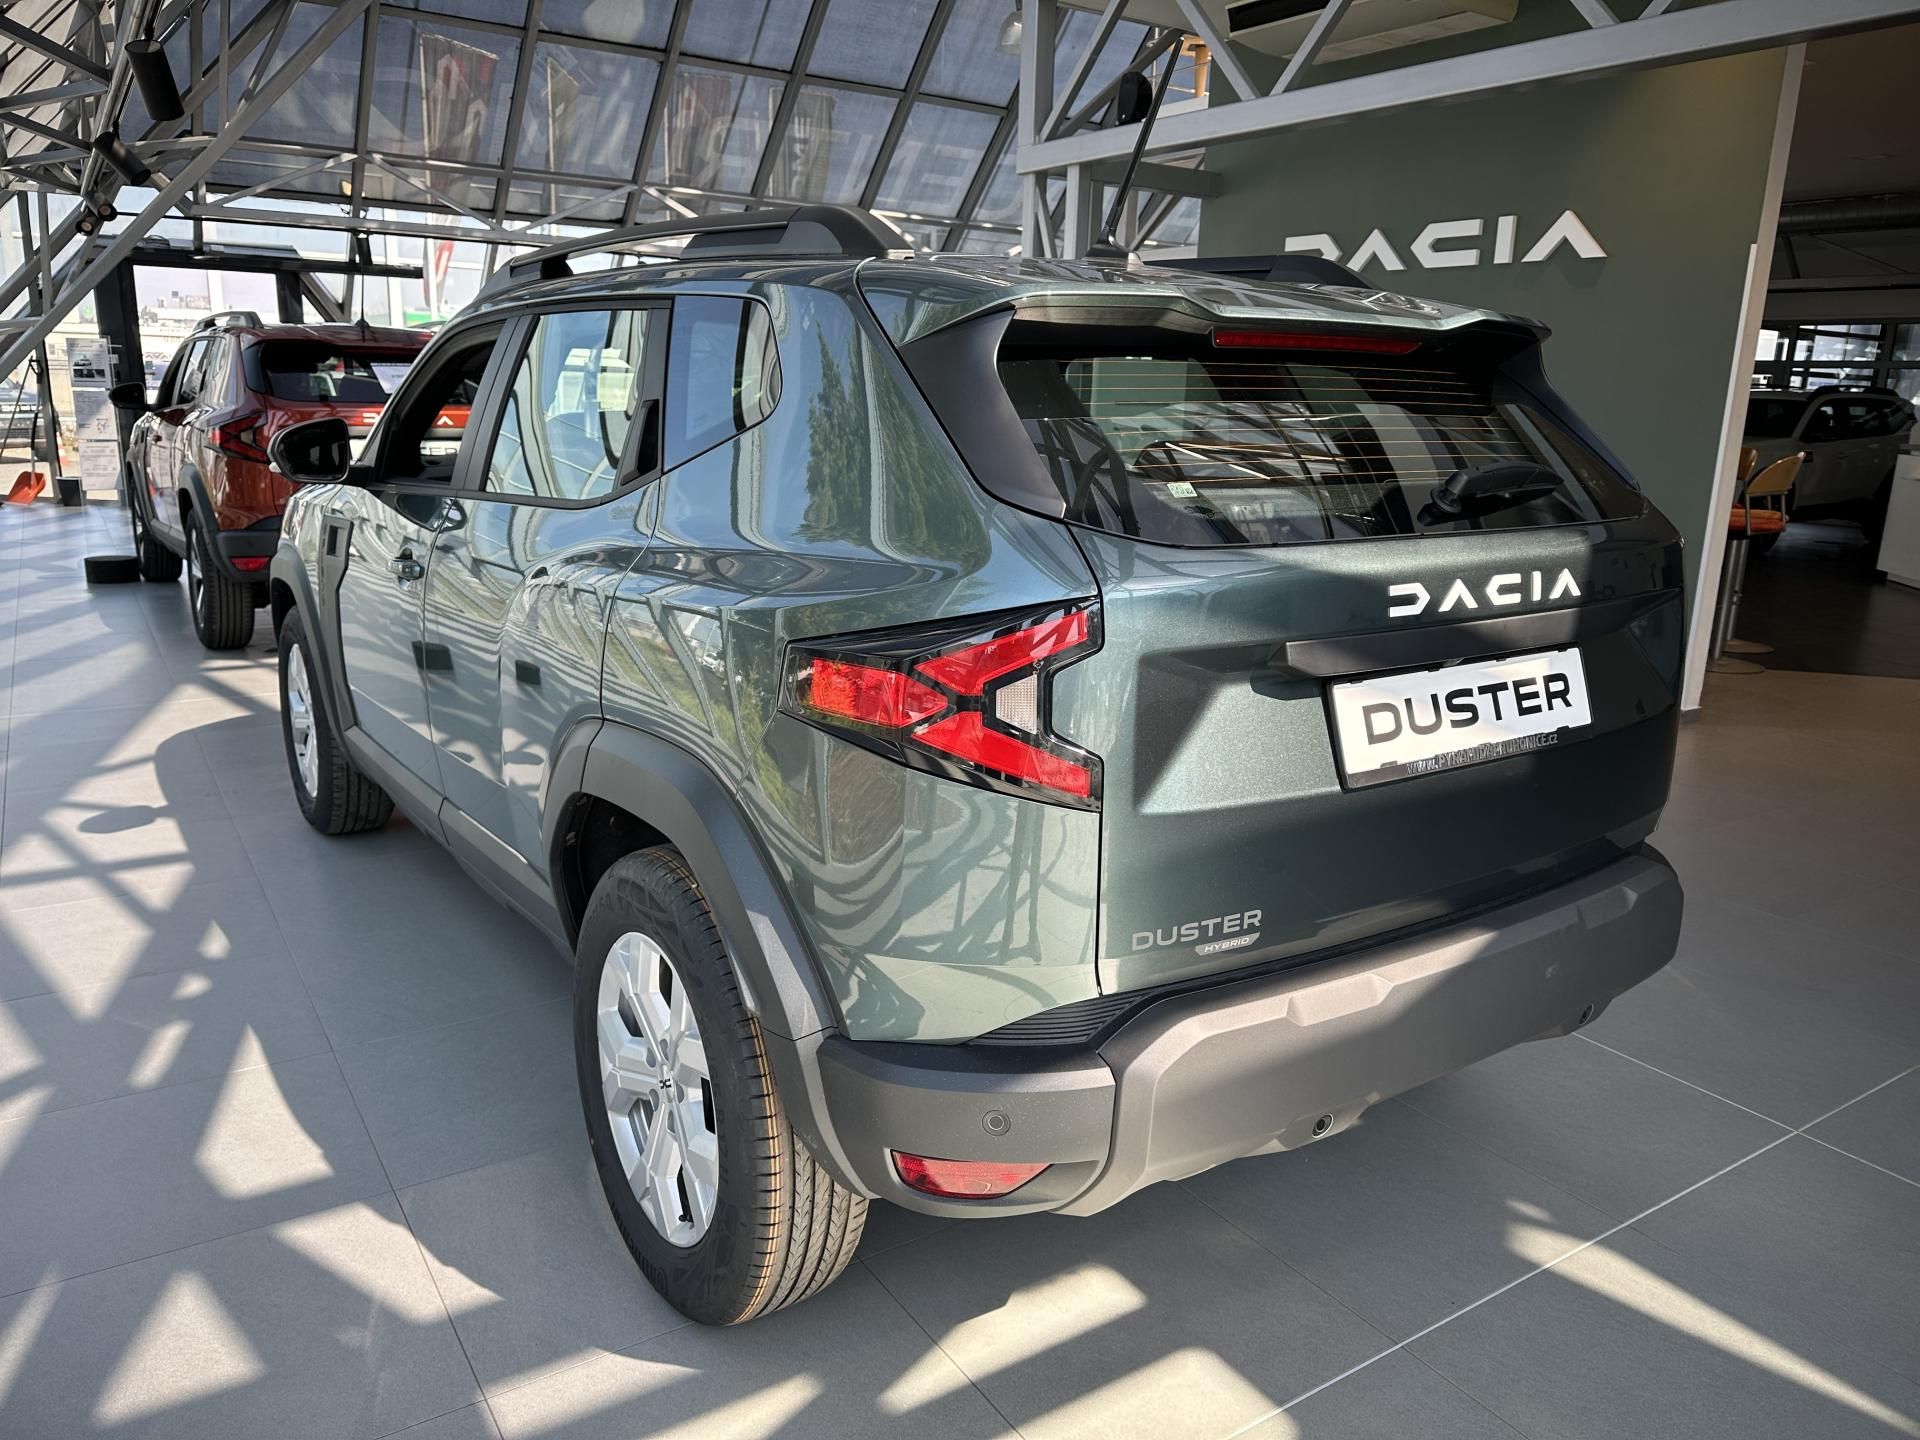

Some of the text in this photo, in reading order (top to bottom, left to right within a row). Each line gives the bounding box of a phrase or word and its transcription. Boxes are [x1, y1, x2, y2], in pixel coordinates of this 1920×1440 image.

[1388, 568, 1582, 618] DACIA
[1361, 672, 1573, 746] DUSTER
[1131, 909, 1262, 951] DUSTER
[1204, 937, 1250, 953] HYBRID
